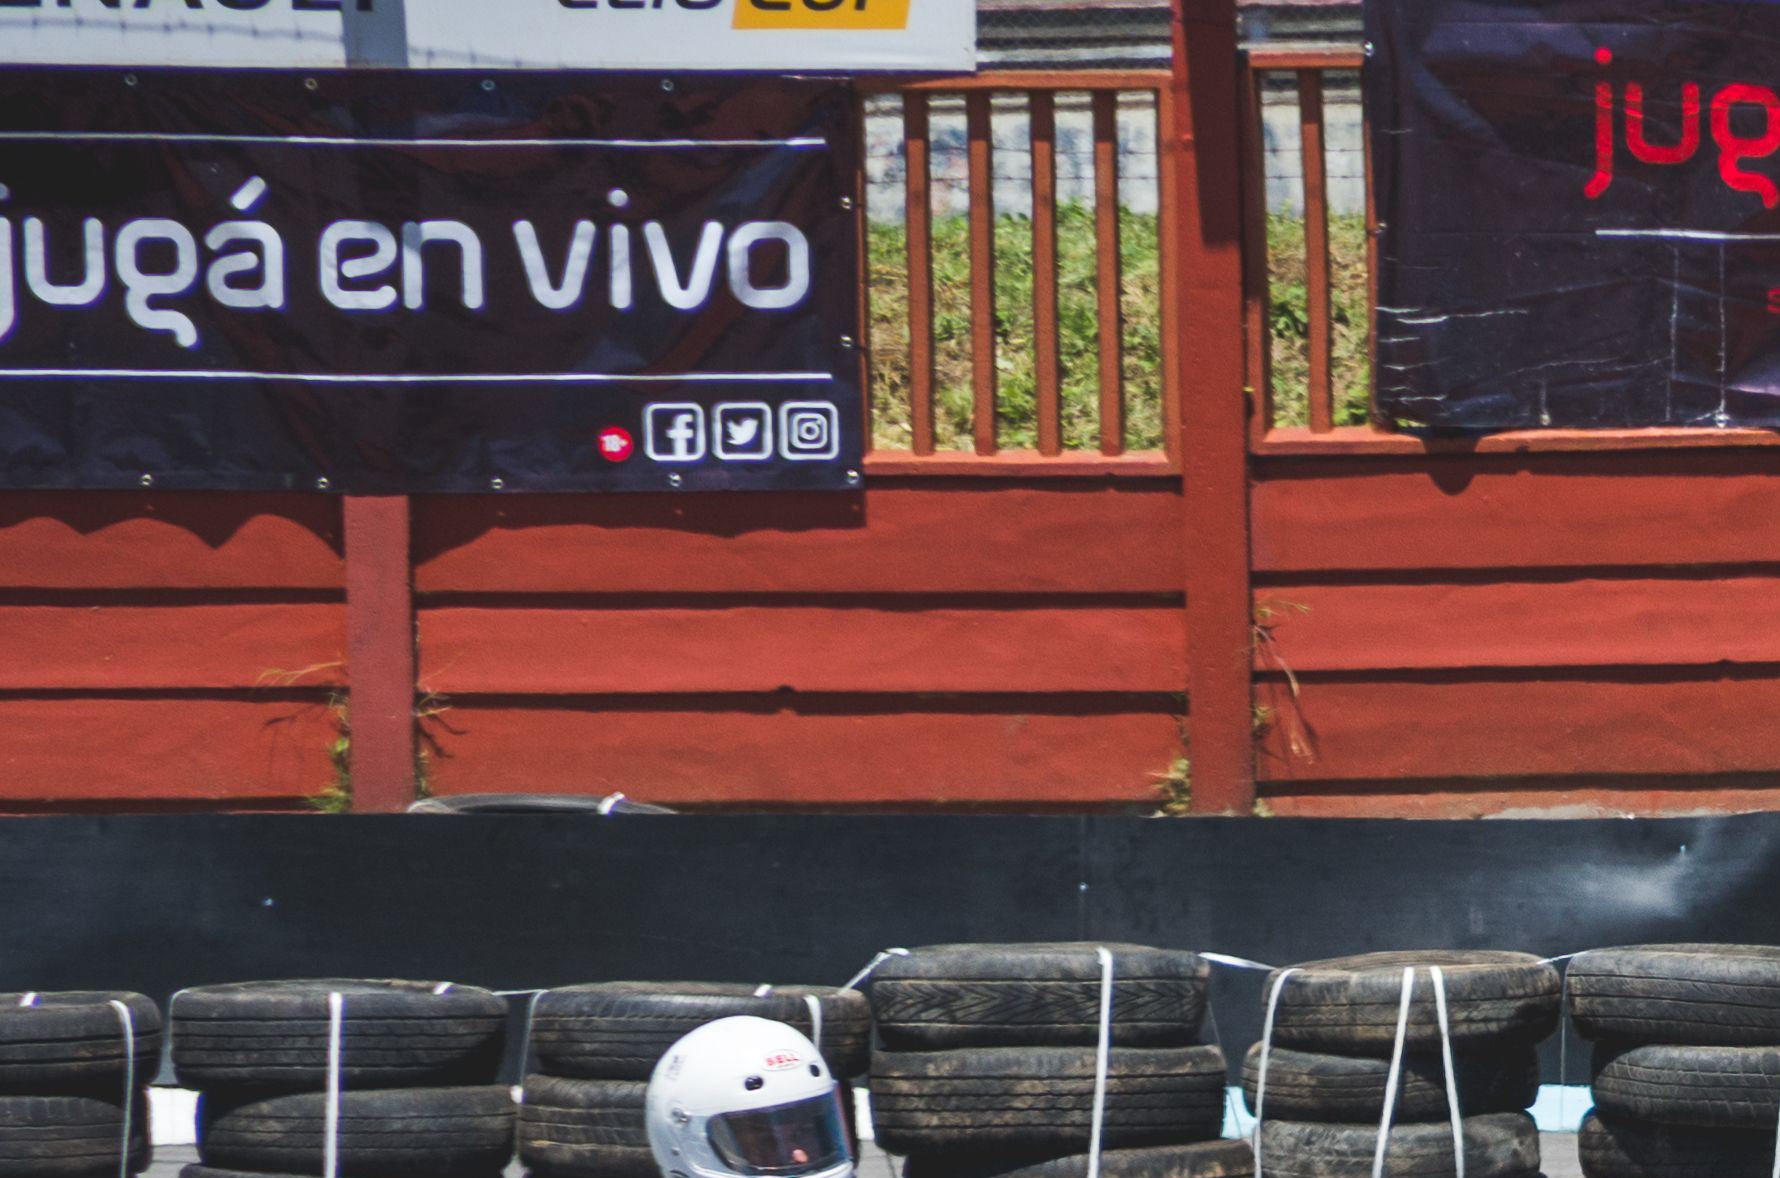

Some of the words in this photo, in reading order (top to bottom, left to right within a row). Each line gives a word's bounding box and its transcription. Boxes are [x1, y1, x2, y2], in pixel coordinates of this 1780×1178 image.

[320, 219, 486, 310] en
[512, 189, 810, 310] vivo
[765, 1053, 801, 1067] BELL
